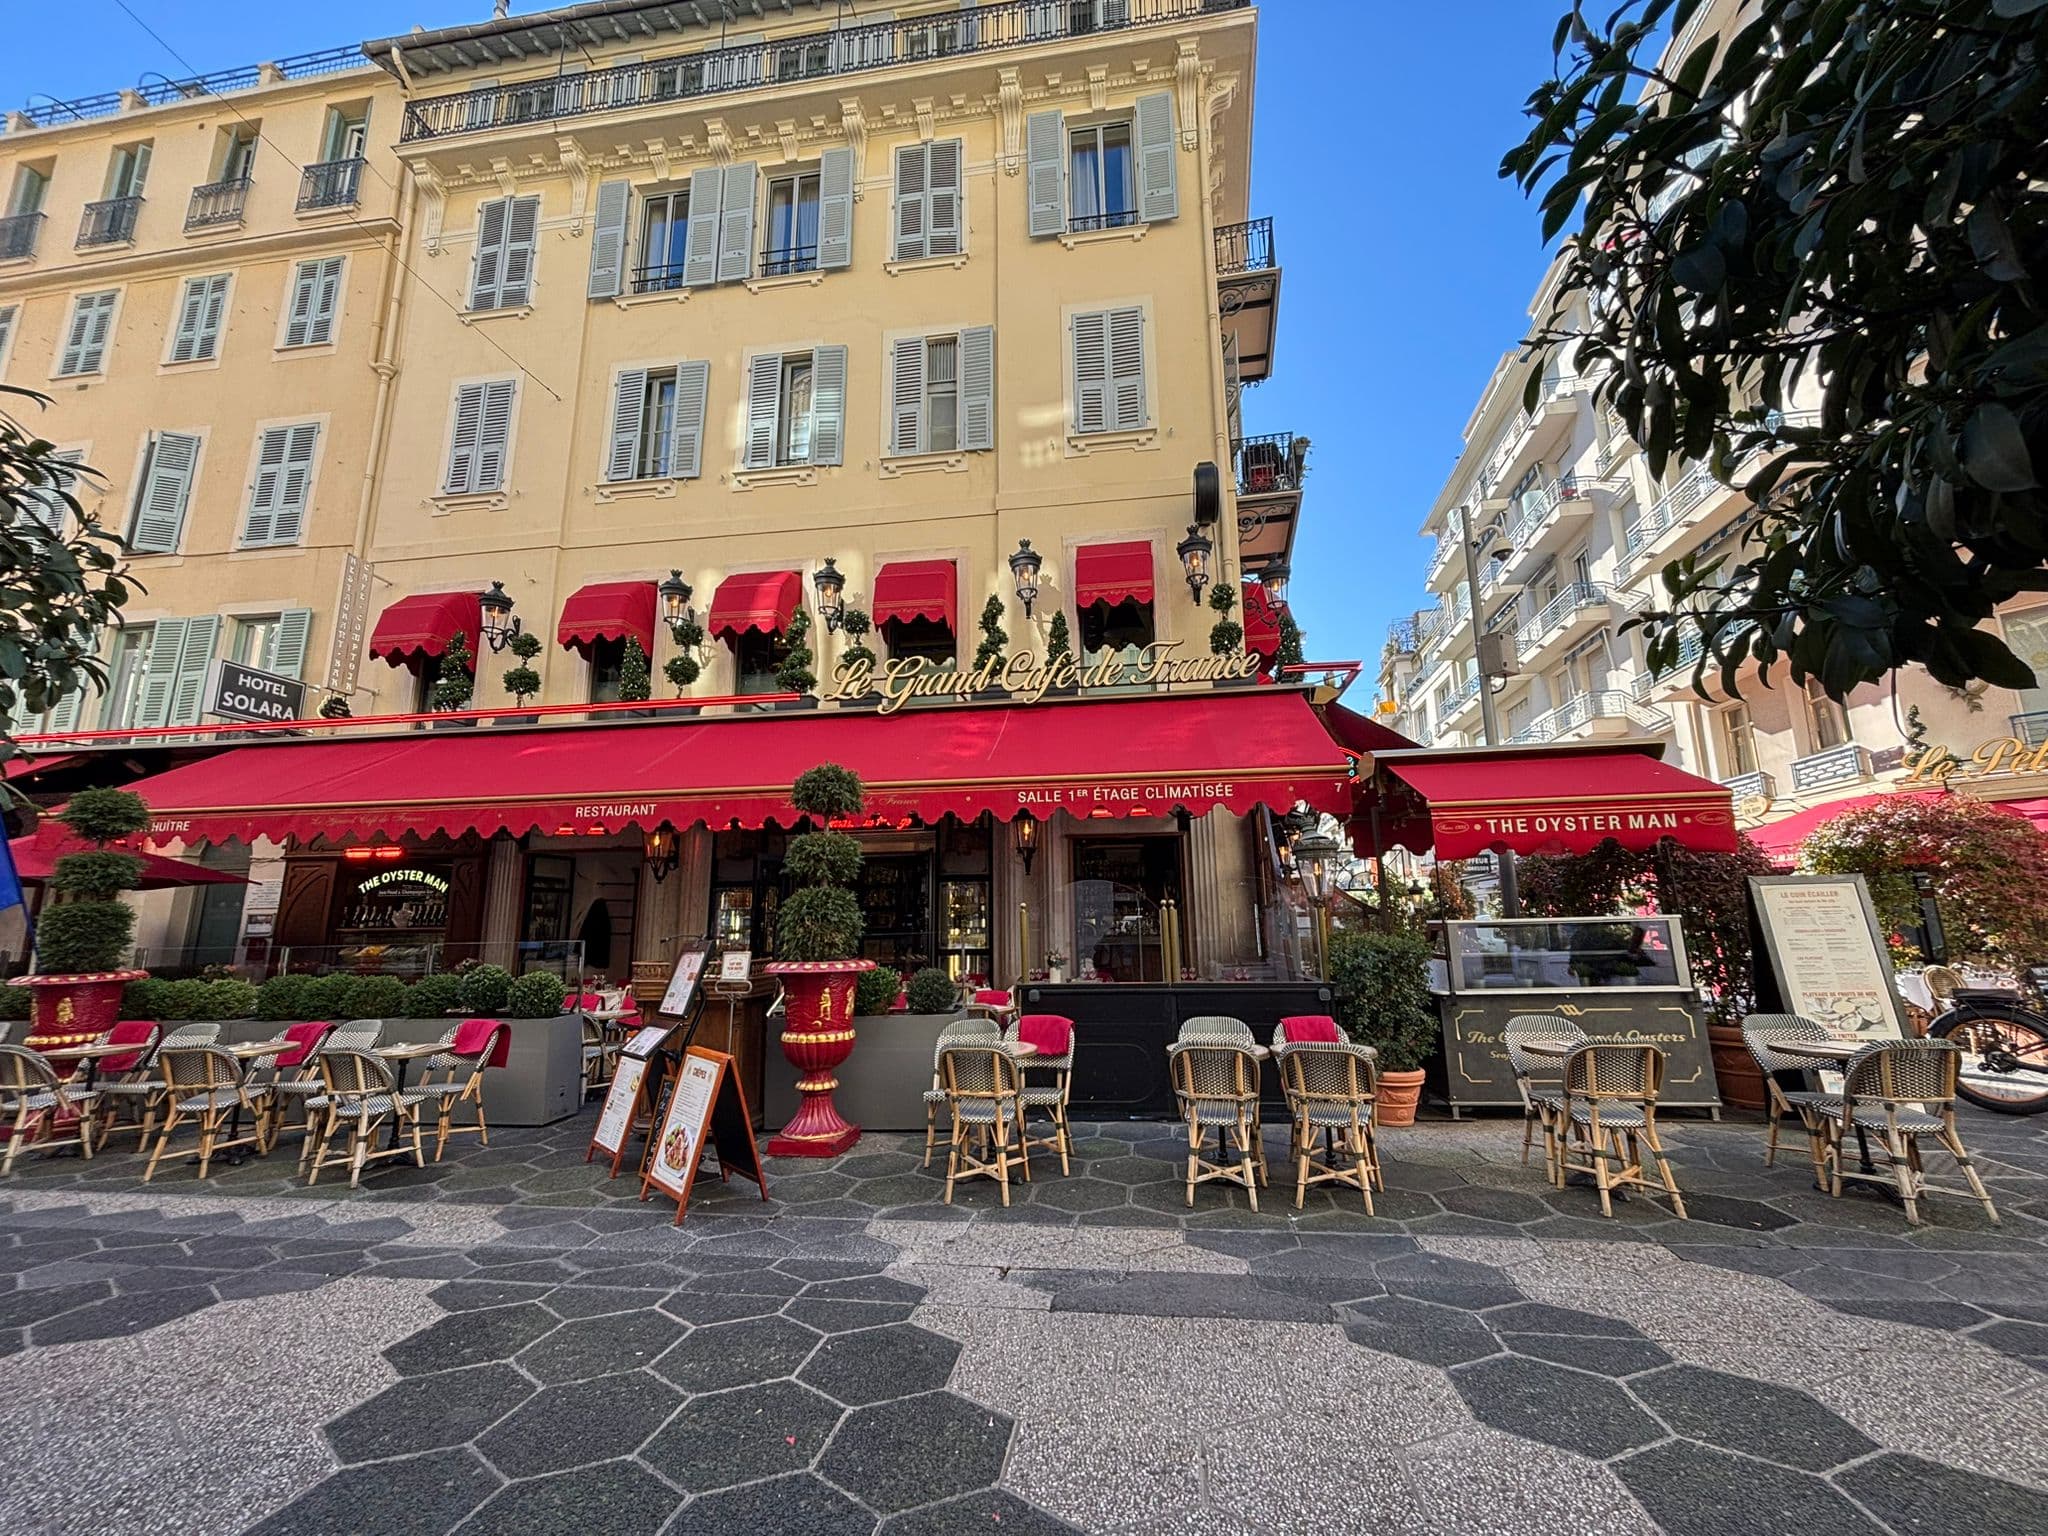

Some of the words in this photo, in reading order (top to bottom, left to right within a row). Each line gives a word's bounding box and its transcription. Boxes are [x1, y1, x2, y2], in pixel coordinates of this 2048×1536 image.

[238, 673, 288, 698] HOTEL
[824, 657, 875, 701] Le
[876, 653, 999, 715] Grand
[1000, 650, 1082, 705] Café
[1081, 650, 1123, 689] de
[1129, 638, 1261, 684] France
[222, 691, 295, 721] SOLARA
[1901, 744, 1957, 784] Le
[1017, 790, 1062, 804] SALLE
[1093, 785, 1140, 801] ÉTAGE
[1145, 782, 1234, 800] CLIMATISÉE
[575, 803, 657, 818] RESTAURANT
[150, 819, 191, 833] HUÎTRE
[1486, 818, 1529, 834] THE
[1535, 815, 1622, 833] OYSTER
[1629, 813, 1678, 829] MAN
[358, 875, 381, 894] THE
[381, 869, 423, 884] OYSTER
[423, 873, 449, 894] MAN
[1467, 1030, 1496, 1044] The
